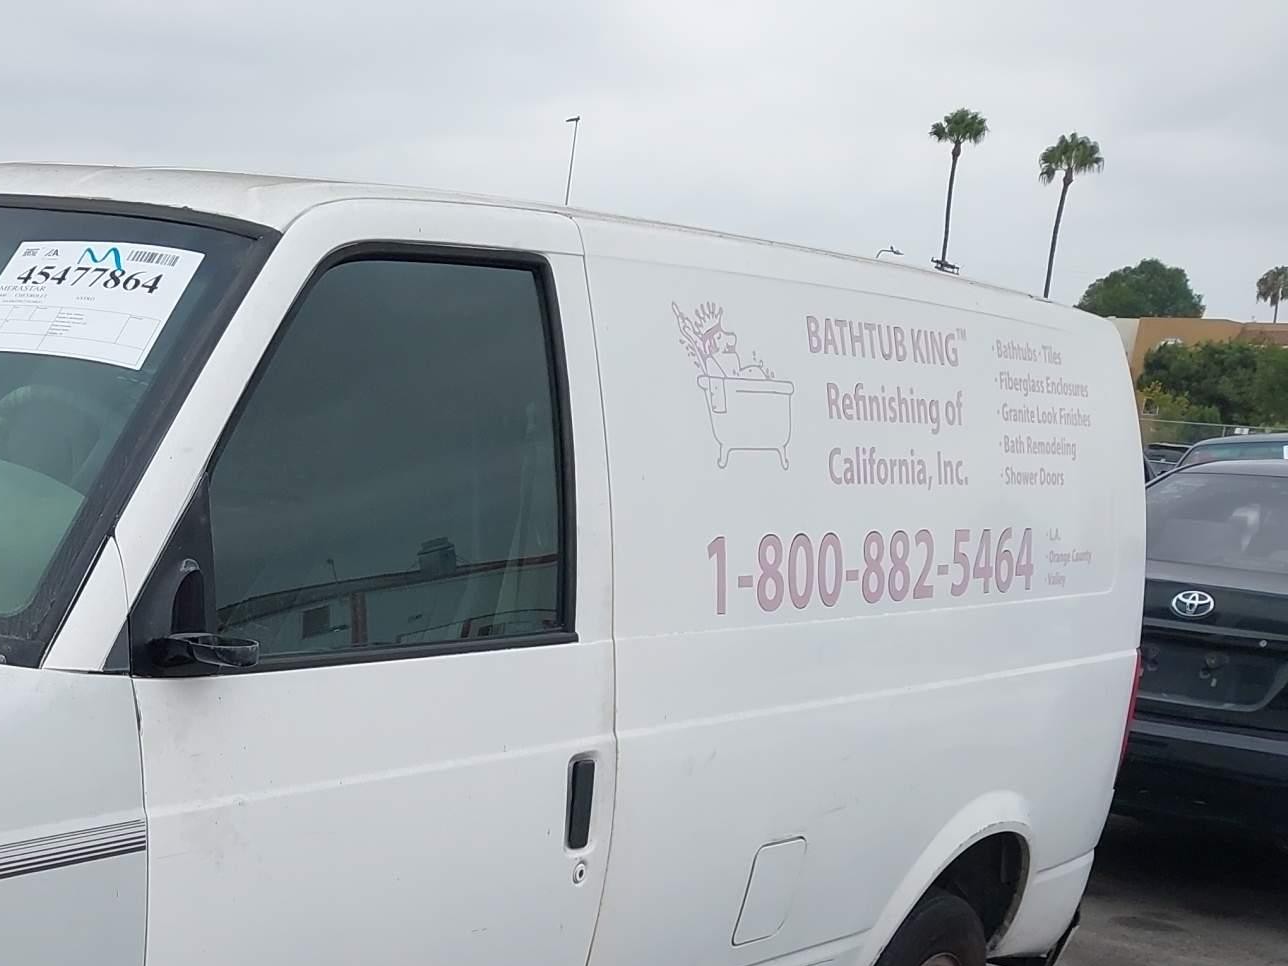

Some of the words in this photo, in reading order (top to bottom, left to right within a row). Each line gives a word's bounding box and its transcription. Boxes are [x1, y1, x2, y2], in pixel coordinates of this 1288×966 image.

[16, 264, 164, 294] 45477864
[805, 314, 908, 363] BATHTUB
[996, 339, 1038, 363] Bathtubs
[1041, 344, 1062, 366] Tiles
[999, 370, 1045, 398] Fiberglass
[1045, 376, 1089, 399] Enclosures
[826, 381, 941, 436] Refinishing
[945, 389, 963, 427] of
[1001, 402, 1036, 424] Granite
[1037, 405, 1058, 426] Look
[1058, 407, 1091, 428] Finishes
[1003, 434, 1025, 454] Bath
[1026, 435, 1077, 461] Remodeling
[828, 445, 933, 492] California,
[936, 450, 969, 487] Inc.
[1004, 466, 1038, 486] Shower
[1039, 467, 1065, 487] Doors
[706, 526, 1034, 615] 1-800-882-5464
[1048, 549, 1071, 567] Orange
